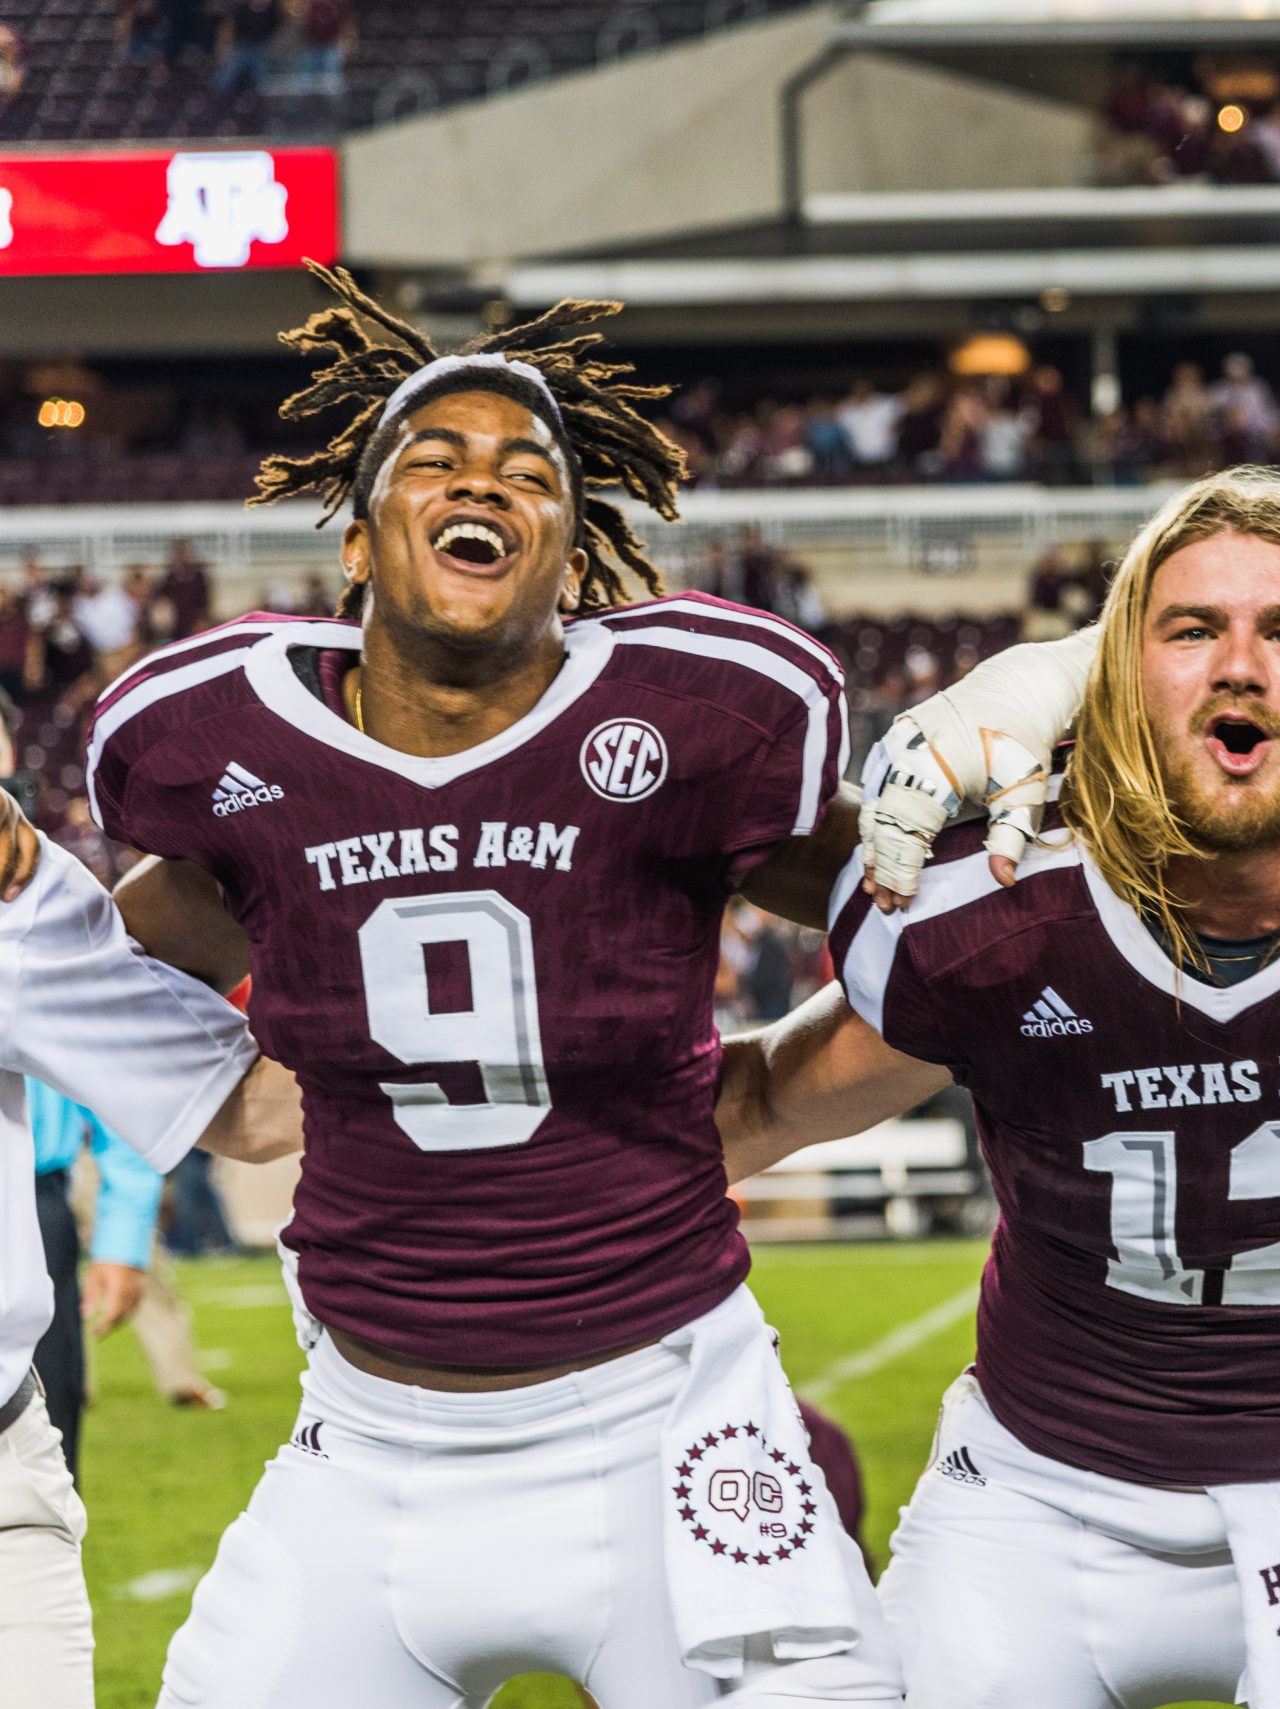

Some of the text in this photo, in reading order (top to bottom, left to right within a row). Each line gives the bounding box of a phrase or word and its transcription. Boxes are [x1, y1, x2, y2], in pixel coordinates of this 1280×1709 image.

[590, 725, 660, 795] SEC
[212, 783, 284, 817] adidas
[305, 821, 580, 891] TEXAS A&M
[357, 889, 553, 1151] 9
[1020, 1014, 1093, 1038] adidas
[1101, 1061, 1261, 1113] TEXAS
[709, 1469, 783, 1523] QC
[760, 1523, 787, 1538] #9
